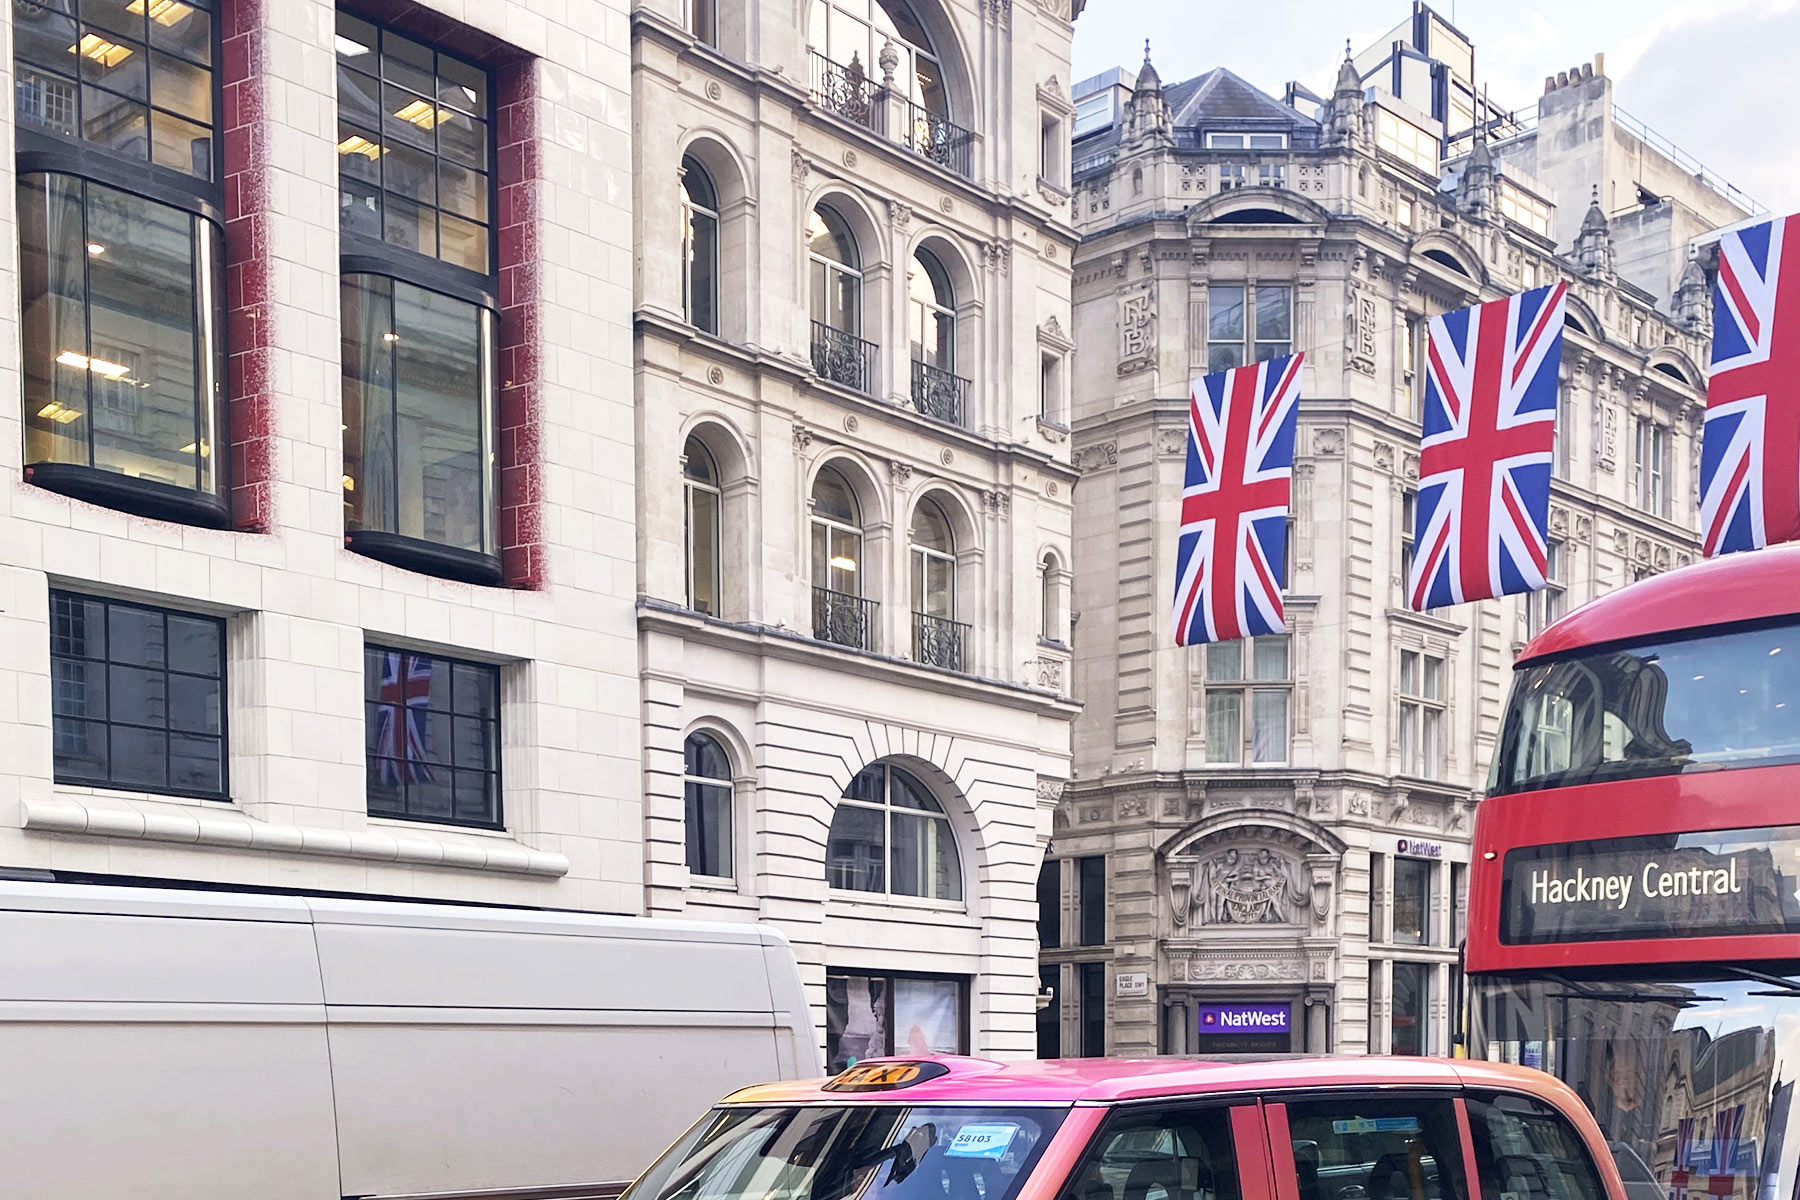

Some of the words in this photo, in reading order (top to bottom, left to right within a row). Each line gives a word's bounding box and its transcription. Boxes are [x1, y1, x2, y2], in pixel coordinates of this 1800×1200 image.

[1409, 840, 1442, 857] NatWest
[1531, 867, 1633, 910] Hackney
[1642, 857, 1741, 898] Central
[1220, 1011, 1286, 1027] NatWest
[837, 1067, 913, 1083] TAXI
[957, 1134, 992, 1143] 58103
